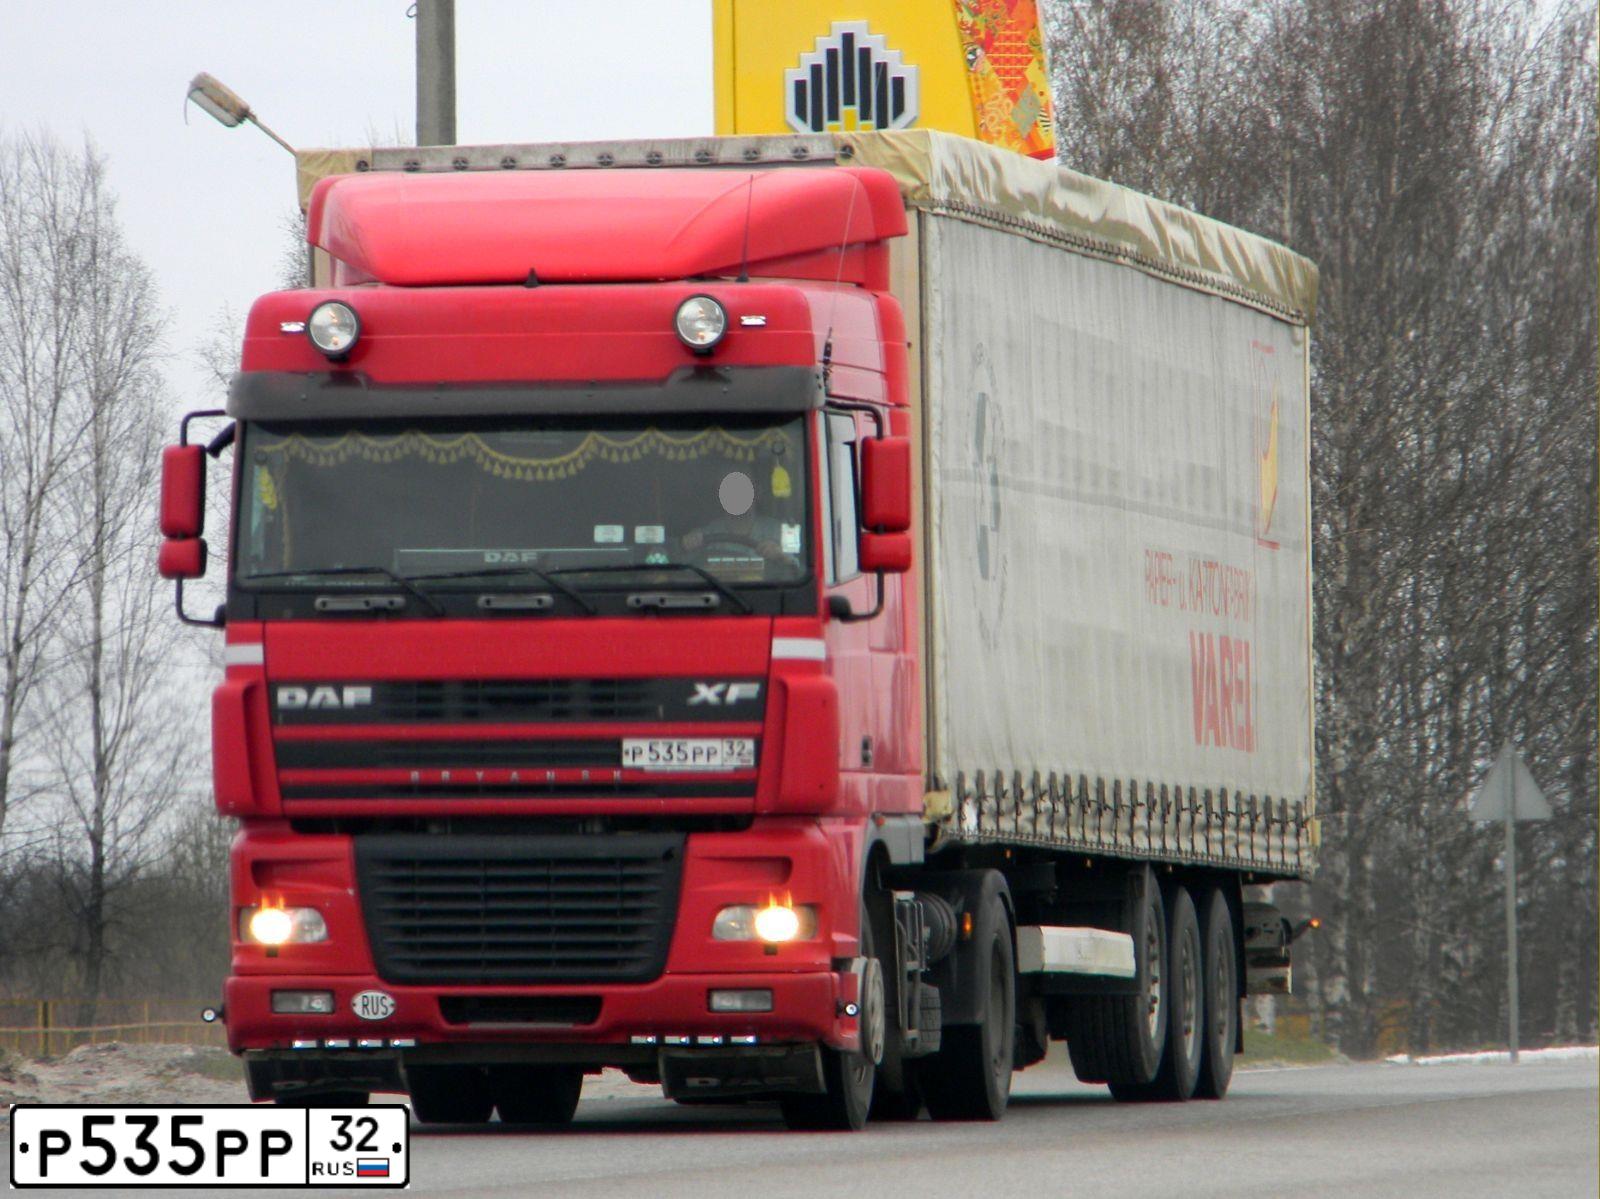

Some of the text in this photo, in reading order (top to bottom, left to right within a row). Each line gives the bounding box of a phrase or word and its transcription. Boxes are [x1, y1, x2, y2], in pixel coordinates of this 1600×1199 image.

[484, 552, 537, 564] DAF
[276, 685, 373, 710] DAF
[687, 682, 761, 706] XF
[1189, 629, 1255, 753] VAREL
[630, 740, 747, 763] P535PP 32
[409, 769, 622, 785] BRYANSK
[361, 994, 389, 1017] RUS
